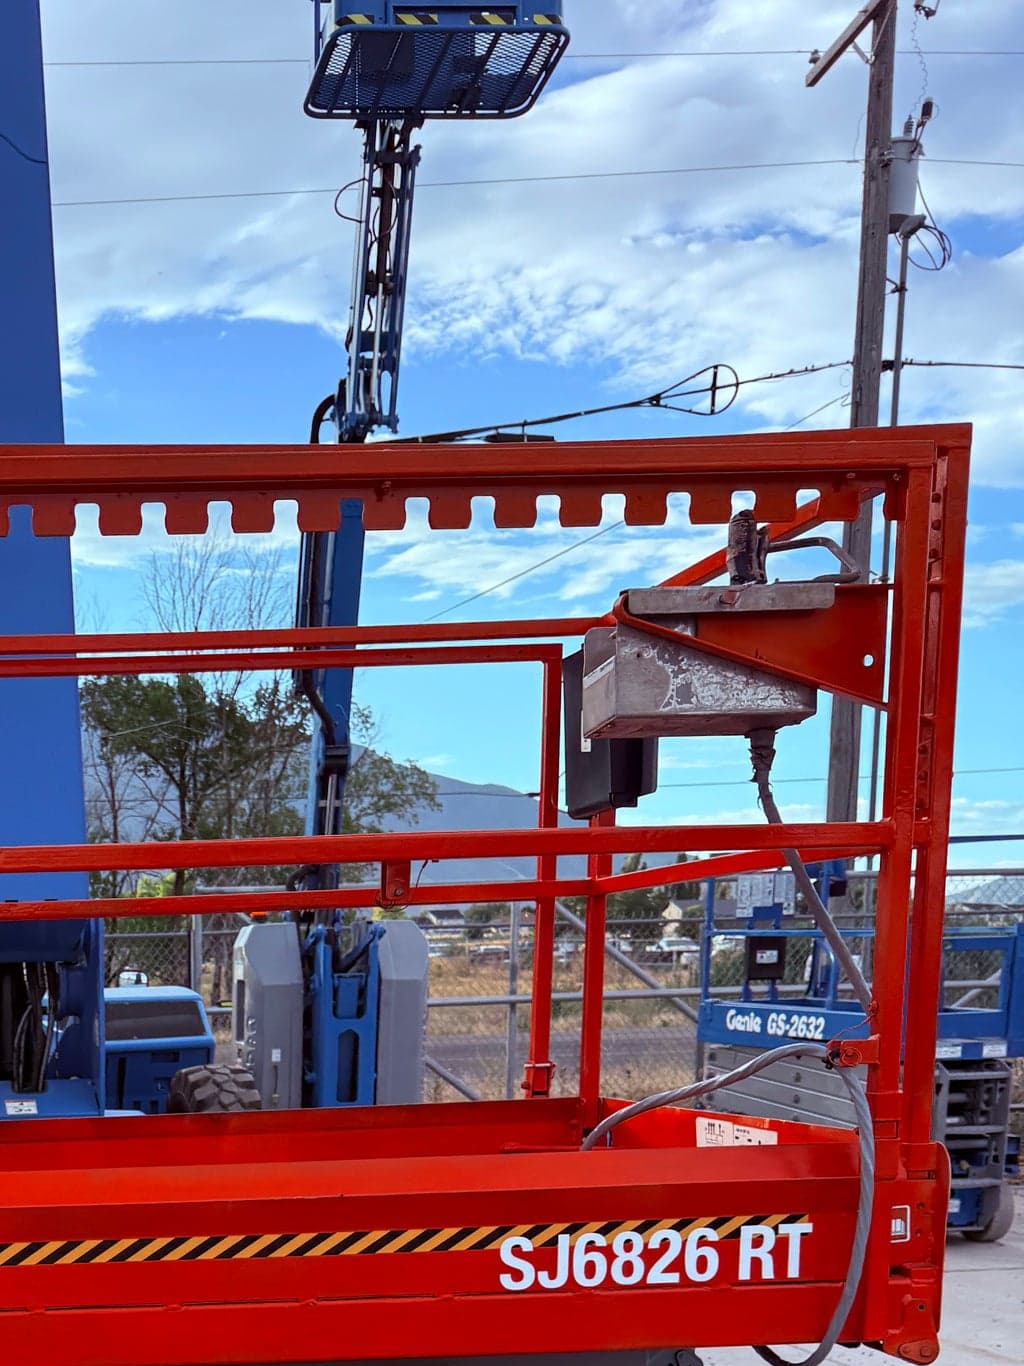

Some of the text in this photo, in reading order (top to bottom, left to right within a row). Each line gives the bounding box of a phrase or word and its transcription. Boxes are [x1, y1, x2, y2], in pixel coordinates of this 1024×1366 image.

[726, 1009, 826, 1040] Genie GS-2632
[499, 1223, 814, 1291] SJ6826 RT
